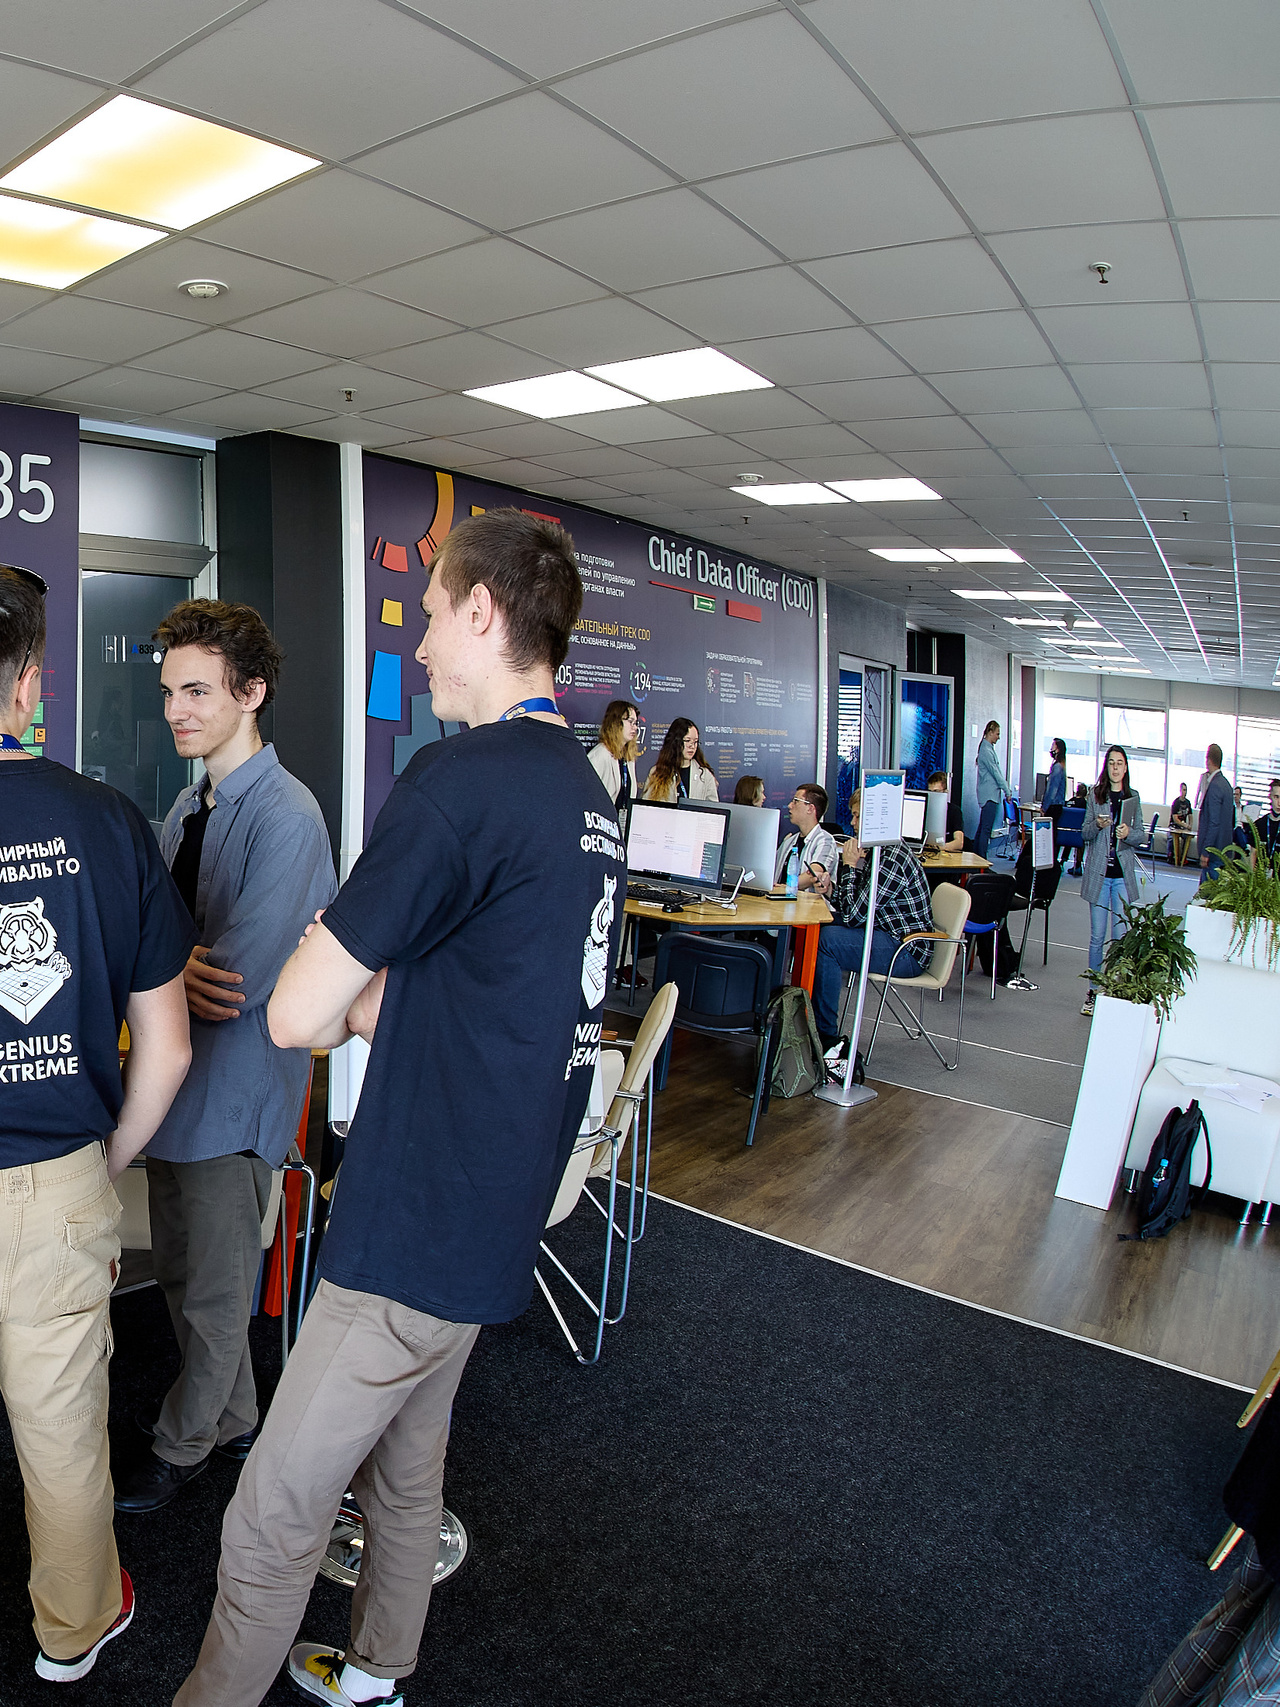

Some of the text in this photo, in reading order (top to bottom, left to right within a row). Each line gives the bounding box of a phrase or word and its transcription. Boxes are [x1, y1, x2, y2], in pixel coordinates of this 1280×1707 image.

[580, 553, 615, 569] подготовки
[593, 570, 601, 579] по
[602, 572, 636, 587] управлению
[648, 536, 814, 618] Chief Data Officer (CDO)
[605, 586, 625, 598] власти
[620, 625, 637, 639] ТРЕК
[634, 672, 652, 691] 194
[616, 844, 625, 863] ГО
[56, 857, 81, 876] ГО
